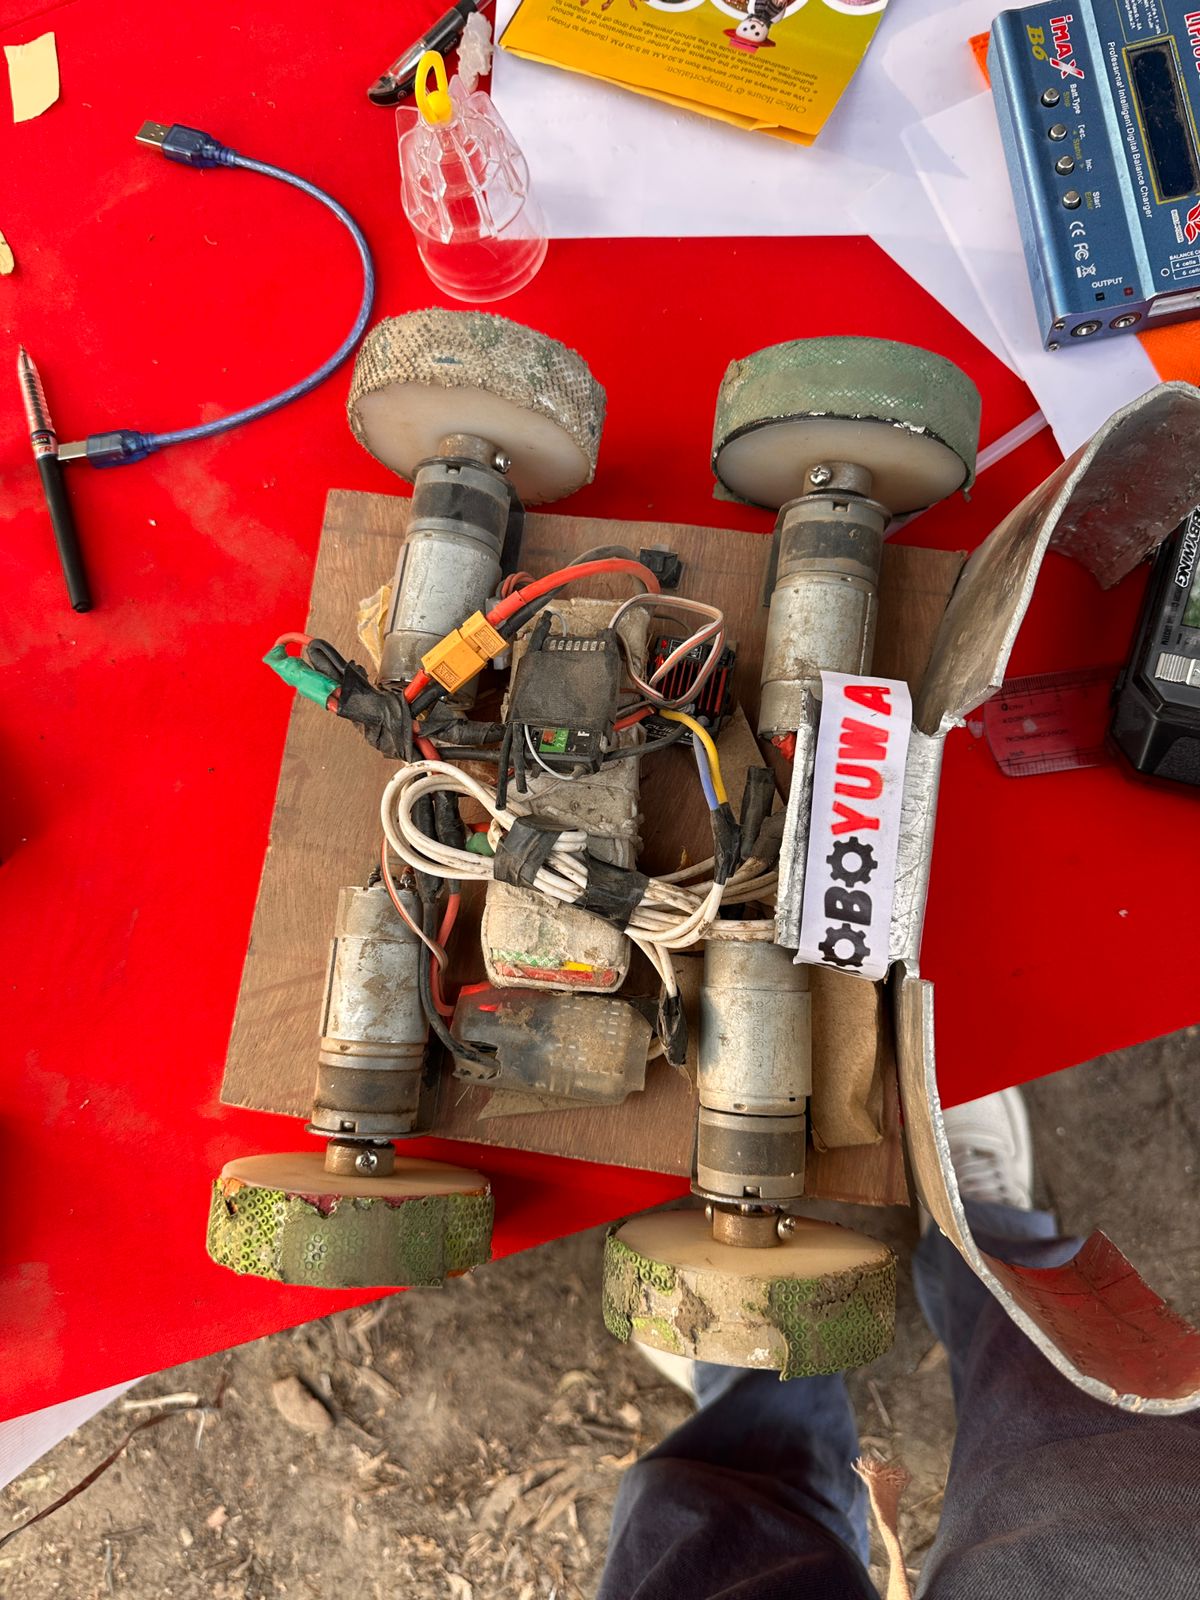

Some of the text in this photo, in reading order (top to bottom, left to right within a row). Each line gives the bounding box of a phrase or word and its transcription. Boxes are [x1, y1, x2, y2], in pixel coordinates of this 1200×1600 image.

[550, 5, 574, 17] school
[589, 11, 601, 19] the
[575, 14, 587, 22] the
[597, 22, 646, 42] consideration
[629, 24, 642, 33] and
[654, 31, 668, 41] pick
[673, 30, 696, 41] school
[1026, 24, 1047, 61] B6
[672, 45, 686, 54] and
[687, 49, 716, 62] parents
[705, 47, 729, 60] school
[684, 59, 701, 69] from
[716, 59, 729, 67] the
[736, 57, 763, 70] provide
[747, 53, 790, 72] destinations
[701, 65, 726, 77] service
[727, 72, 743, 81] your
[739, 65, 769, 79] request
[753, 80, 778, 92] always
[770, 75, 797, 88] special
[792, 93, 805, 101] We
[1116, 88, 1133, 127] Intelligent
[1125, 127, 1138, 152] Digital
[1131, 153, 1146, 185] Balance
[1091, 191, 1102, 208] Start
[1138, 185, 1153, 218] Charger
[1168, 250, 1194, 260] BALANCE
[1091, 276, 1123, 288] OUTPUT
